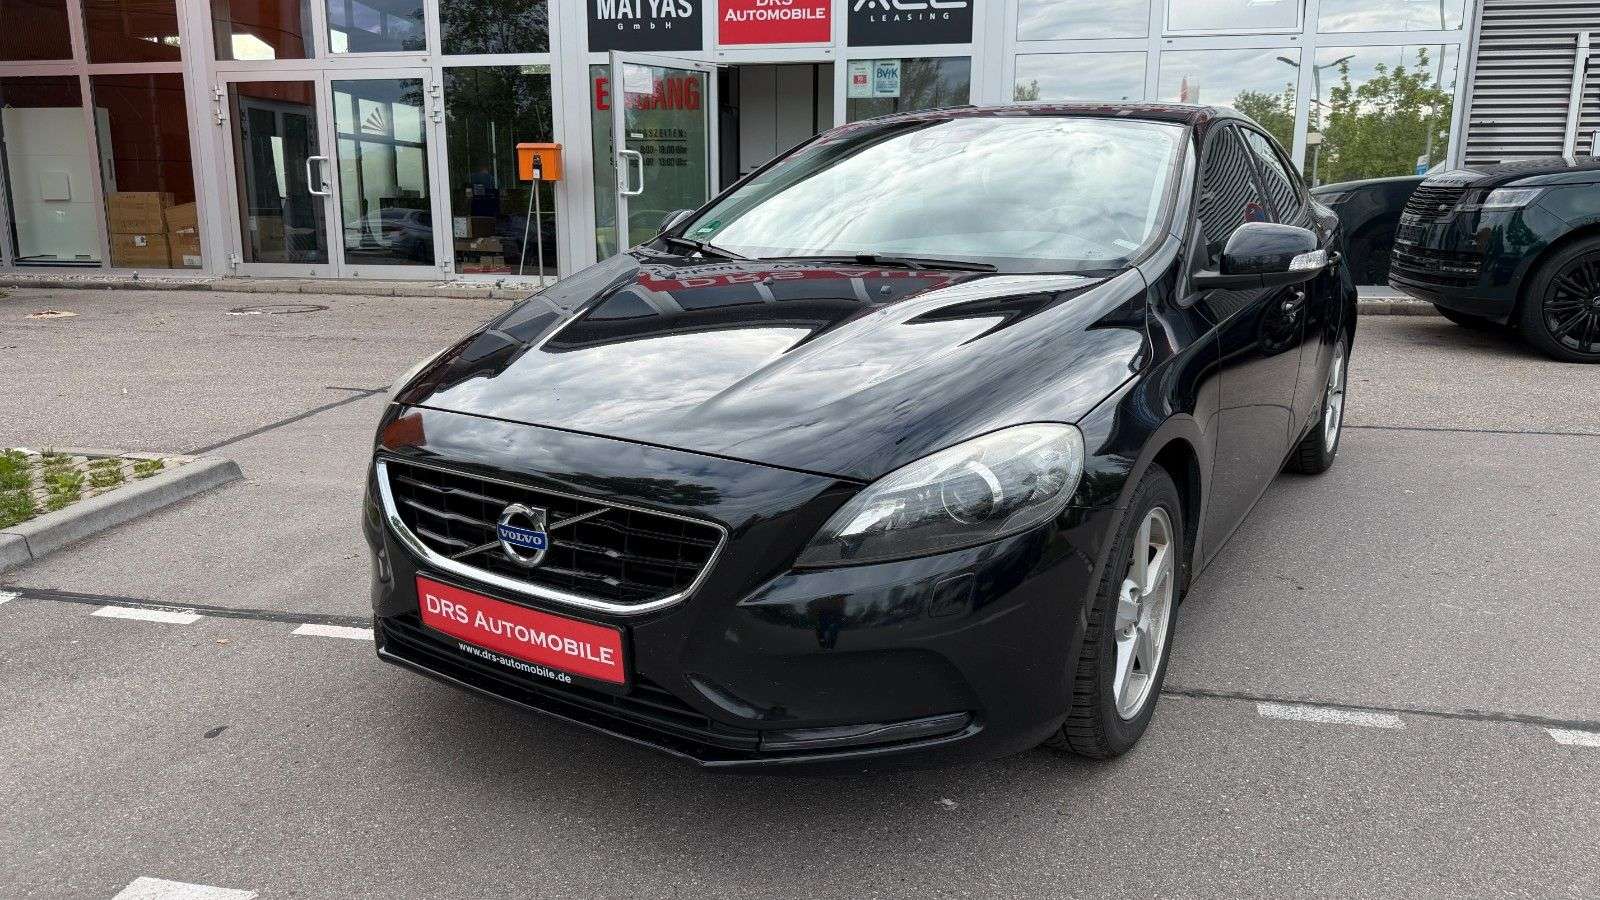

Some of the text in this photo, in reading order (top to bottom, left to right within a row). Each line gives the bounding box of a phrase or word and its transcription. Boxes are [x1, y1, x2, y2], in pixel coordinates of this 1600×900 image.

[724, 8, 826, 22] AUTOMOBILE
[870, 12, 950, 22] LEASING
[500, 528, 542, 545] VOLVO
[426, 593, 615, 665] DRS AUTOMOBILE
[458, 641, 572, 684] www.drs-automobile.de
